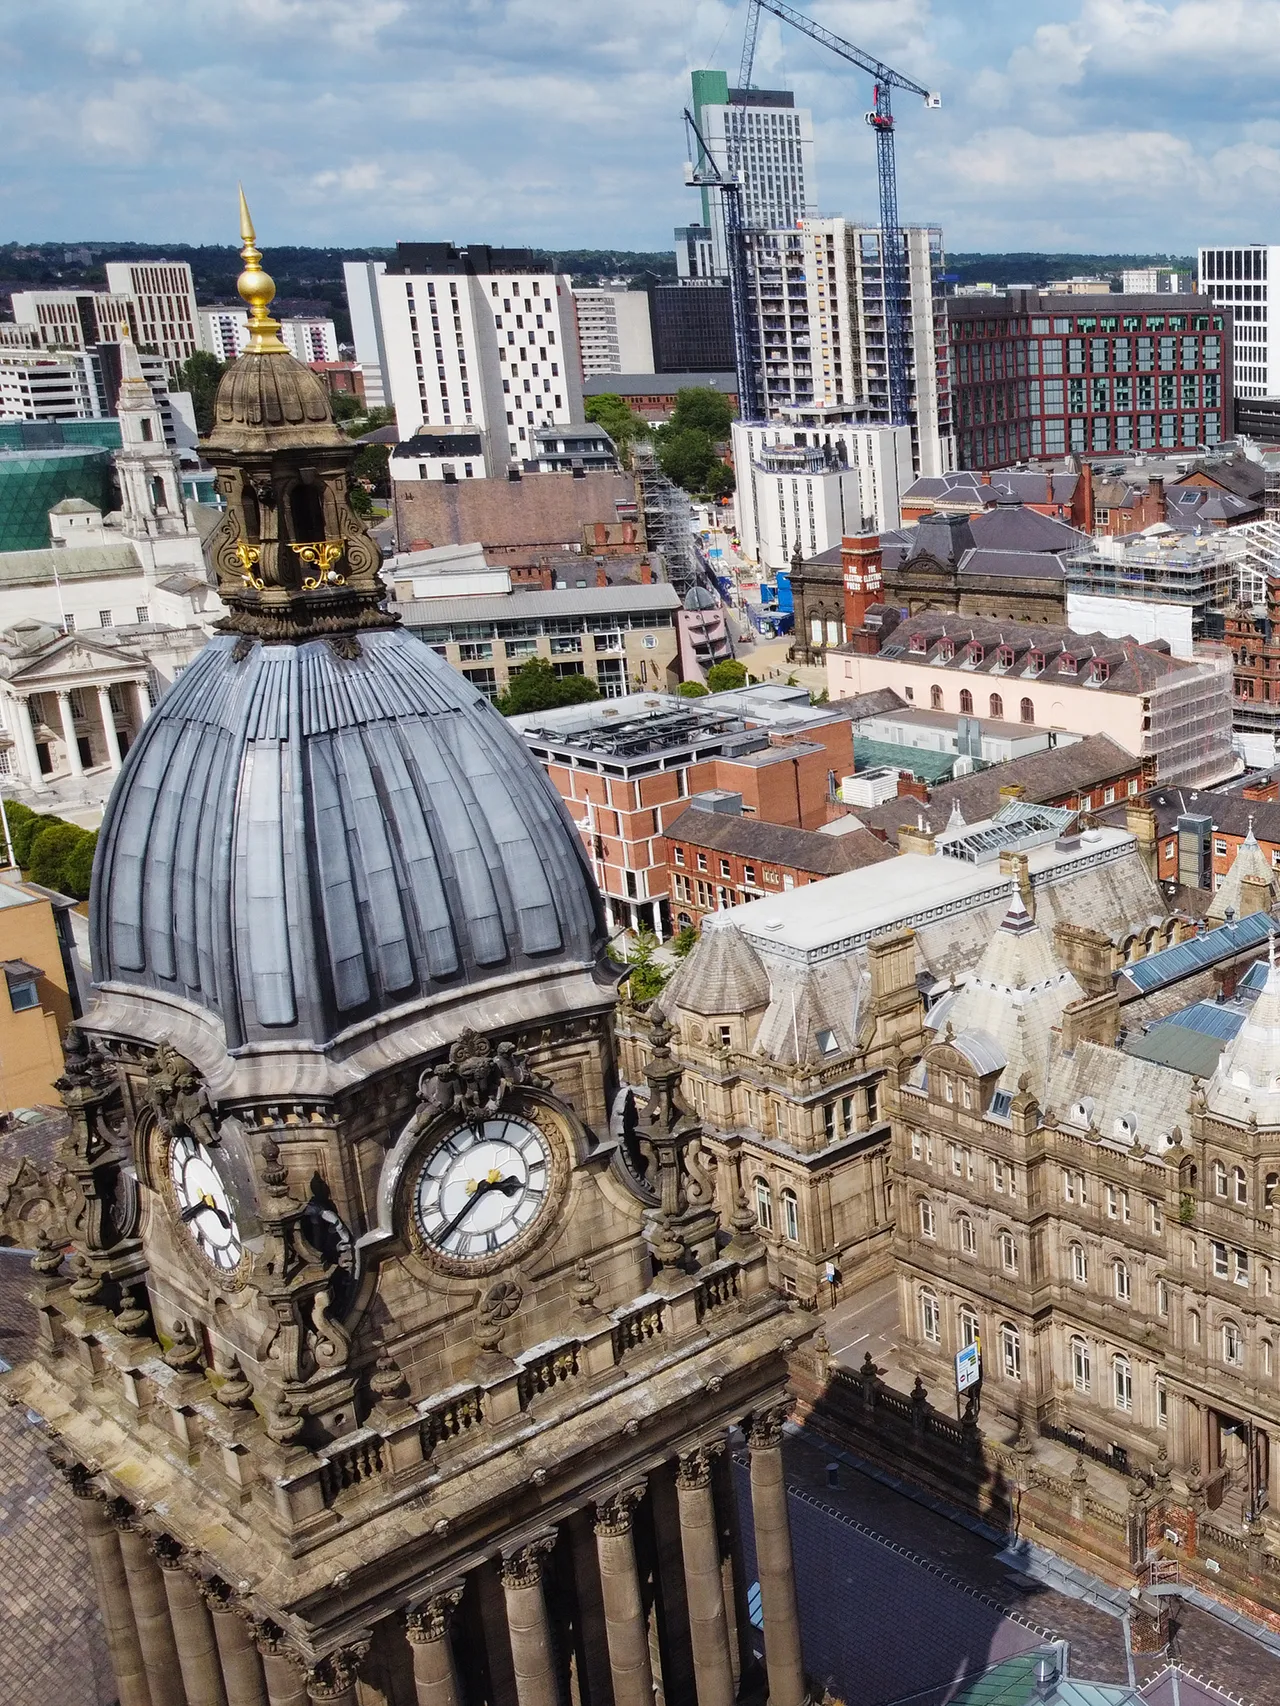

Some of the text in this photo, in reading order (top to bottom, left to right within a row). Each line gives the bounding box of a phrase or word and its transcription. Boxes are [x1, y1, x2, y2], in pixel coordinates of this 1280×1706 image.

[849, 566, 857, 574] THE
[868, 565, 876, 573] THE
[844, 574, 862, 583] ELECTRIC
[864, 573, 881, 582] ELECTRIC
[847, 581, 860, 590] PRESS
[866, 581, 880, 590] PRESS
